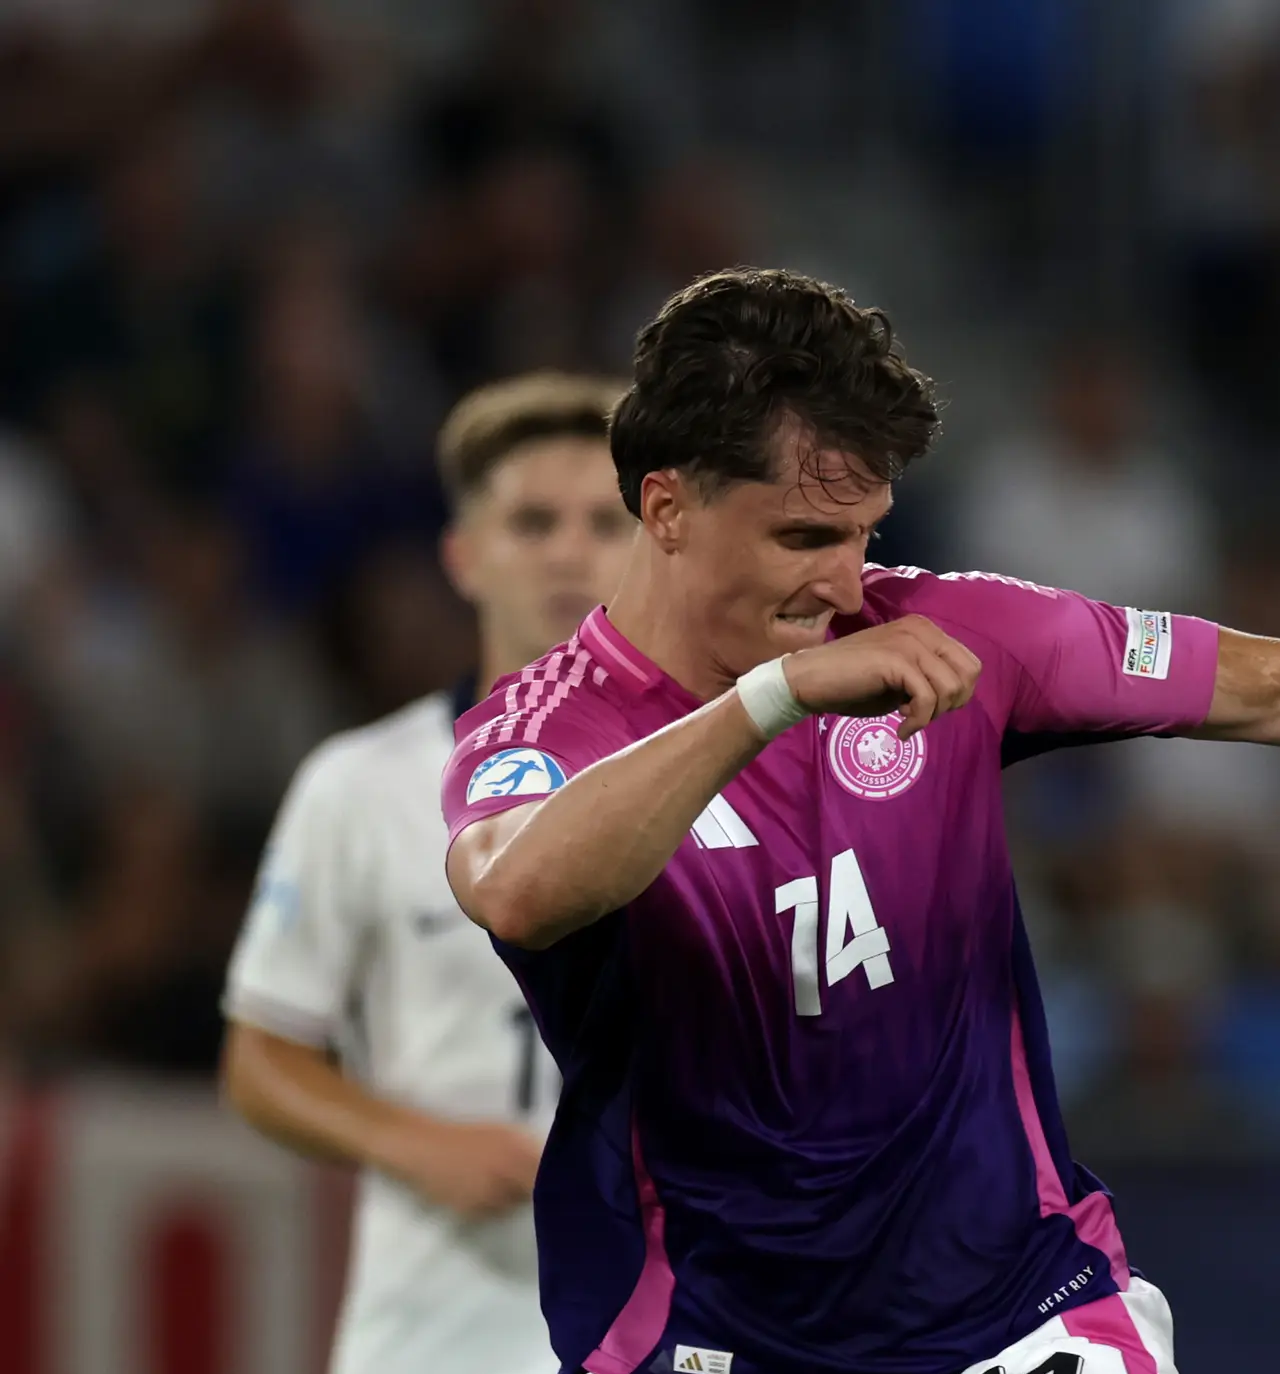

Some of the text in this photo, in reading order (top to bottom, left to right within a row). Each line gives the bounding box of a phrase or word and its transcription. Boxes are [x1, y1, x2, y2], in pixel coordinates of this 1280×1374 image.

[1126, 648, 1137, 672] UEFA
[842, 715, 888, 748] DEUTSCHER
[774, 848, 895, 1016] 14
